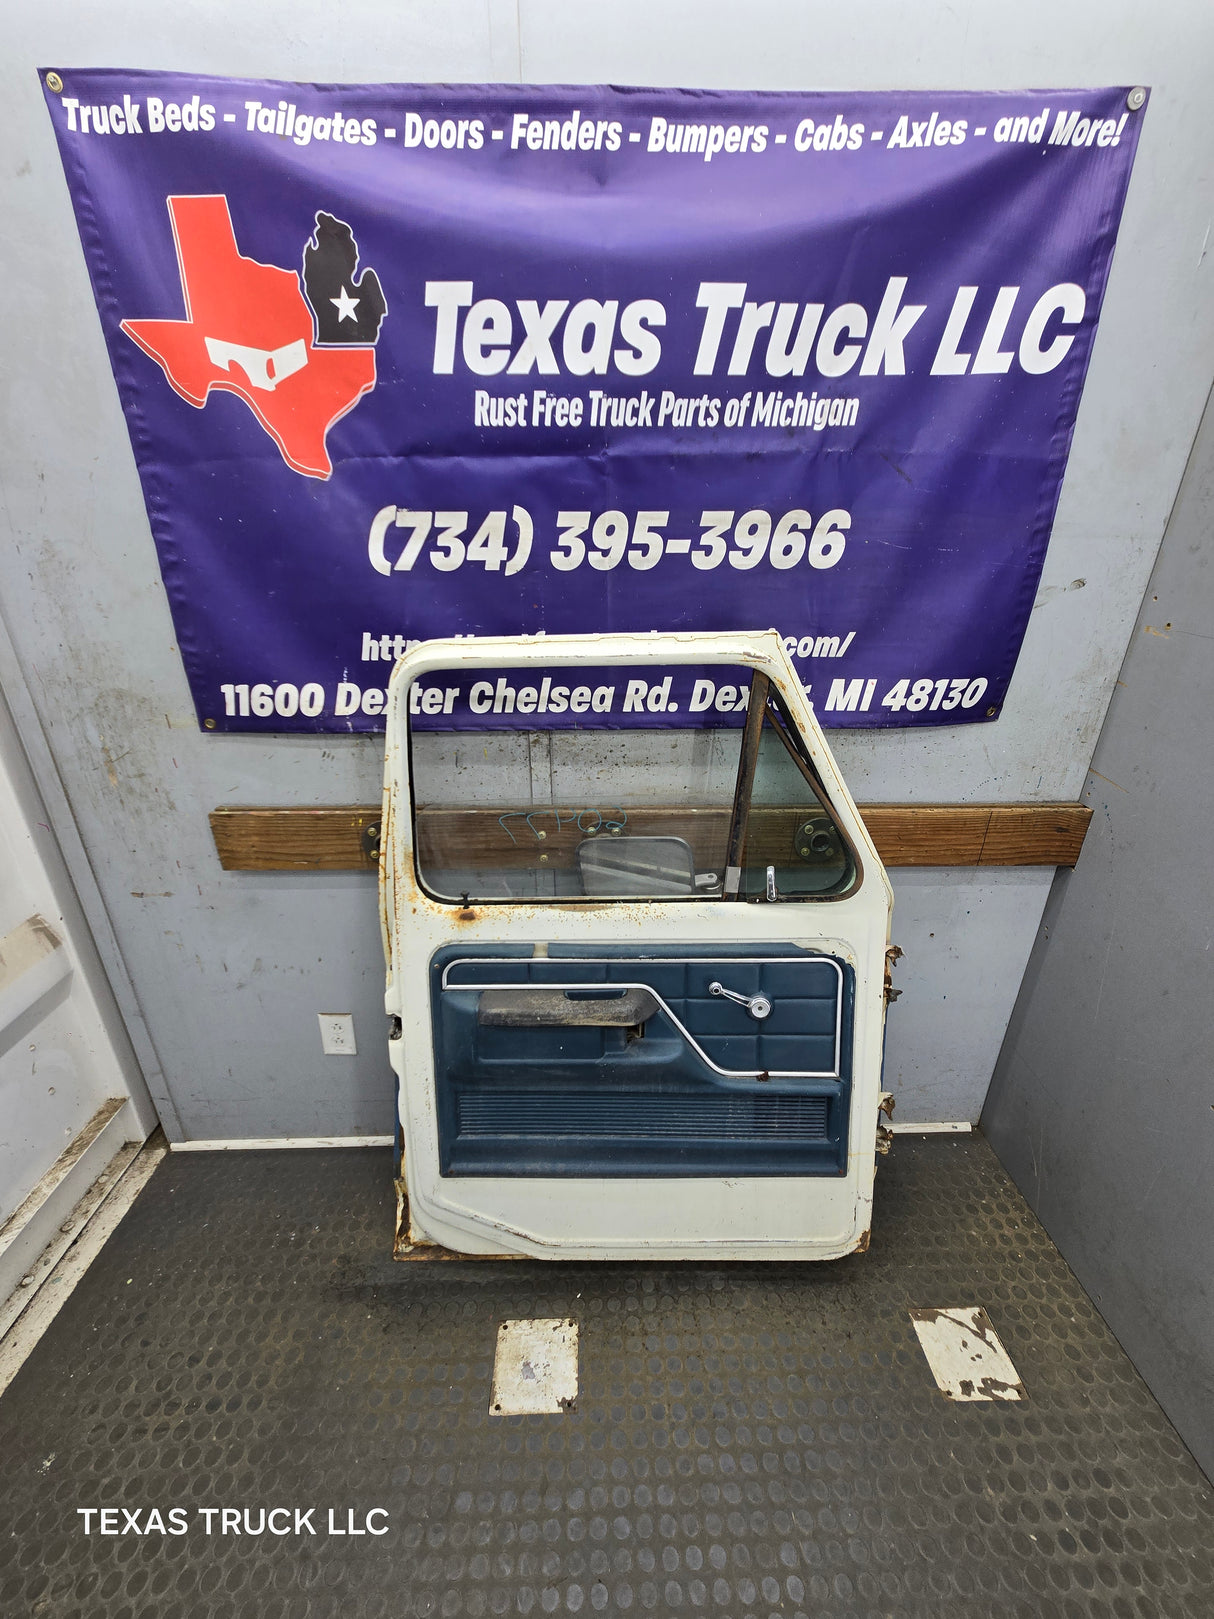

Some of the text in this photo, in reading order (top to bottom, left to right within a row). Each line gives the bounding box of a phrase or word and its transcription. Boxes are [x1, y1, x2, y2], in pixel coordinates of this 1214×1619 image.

[61, 96, 1129, 162] Truck Beds - Tailgates - Doors - Fenders - Bumpers - Cabs - Axles - and More!
[425, 276, 1086, 378] Texas Truck LLC
[474, 389, 859, 432] Rust Free Truck Parts of Michigan
[368, 504, 852, 577] (734) 395-3966
[221, 683, 325, 717] 11600
[469, 677, 615, 714] Chelsea
[623, 676, 679, 713] Rd.
[825, 678, 877, 712] MI
[881, 677, 989, 712] 48130
